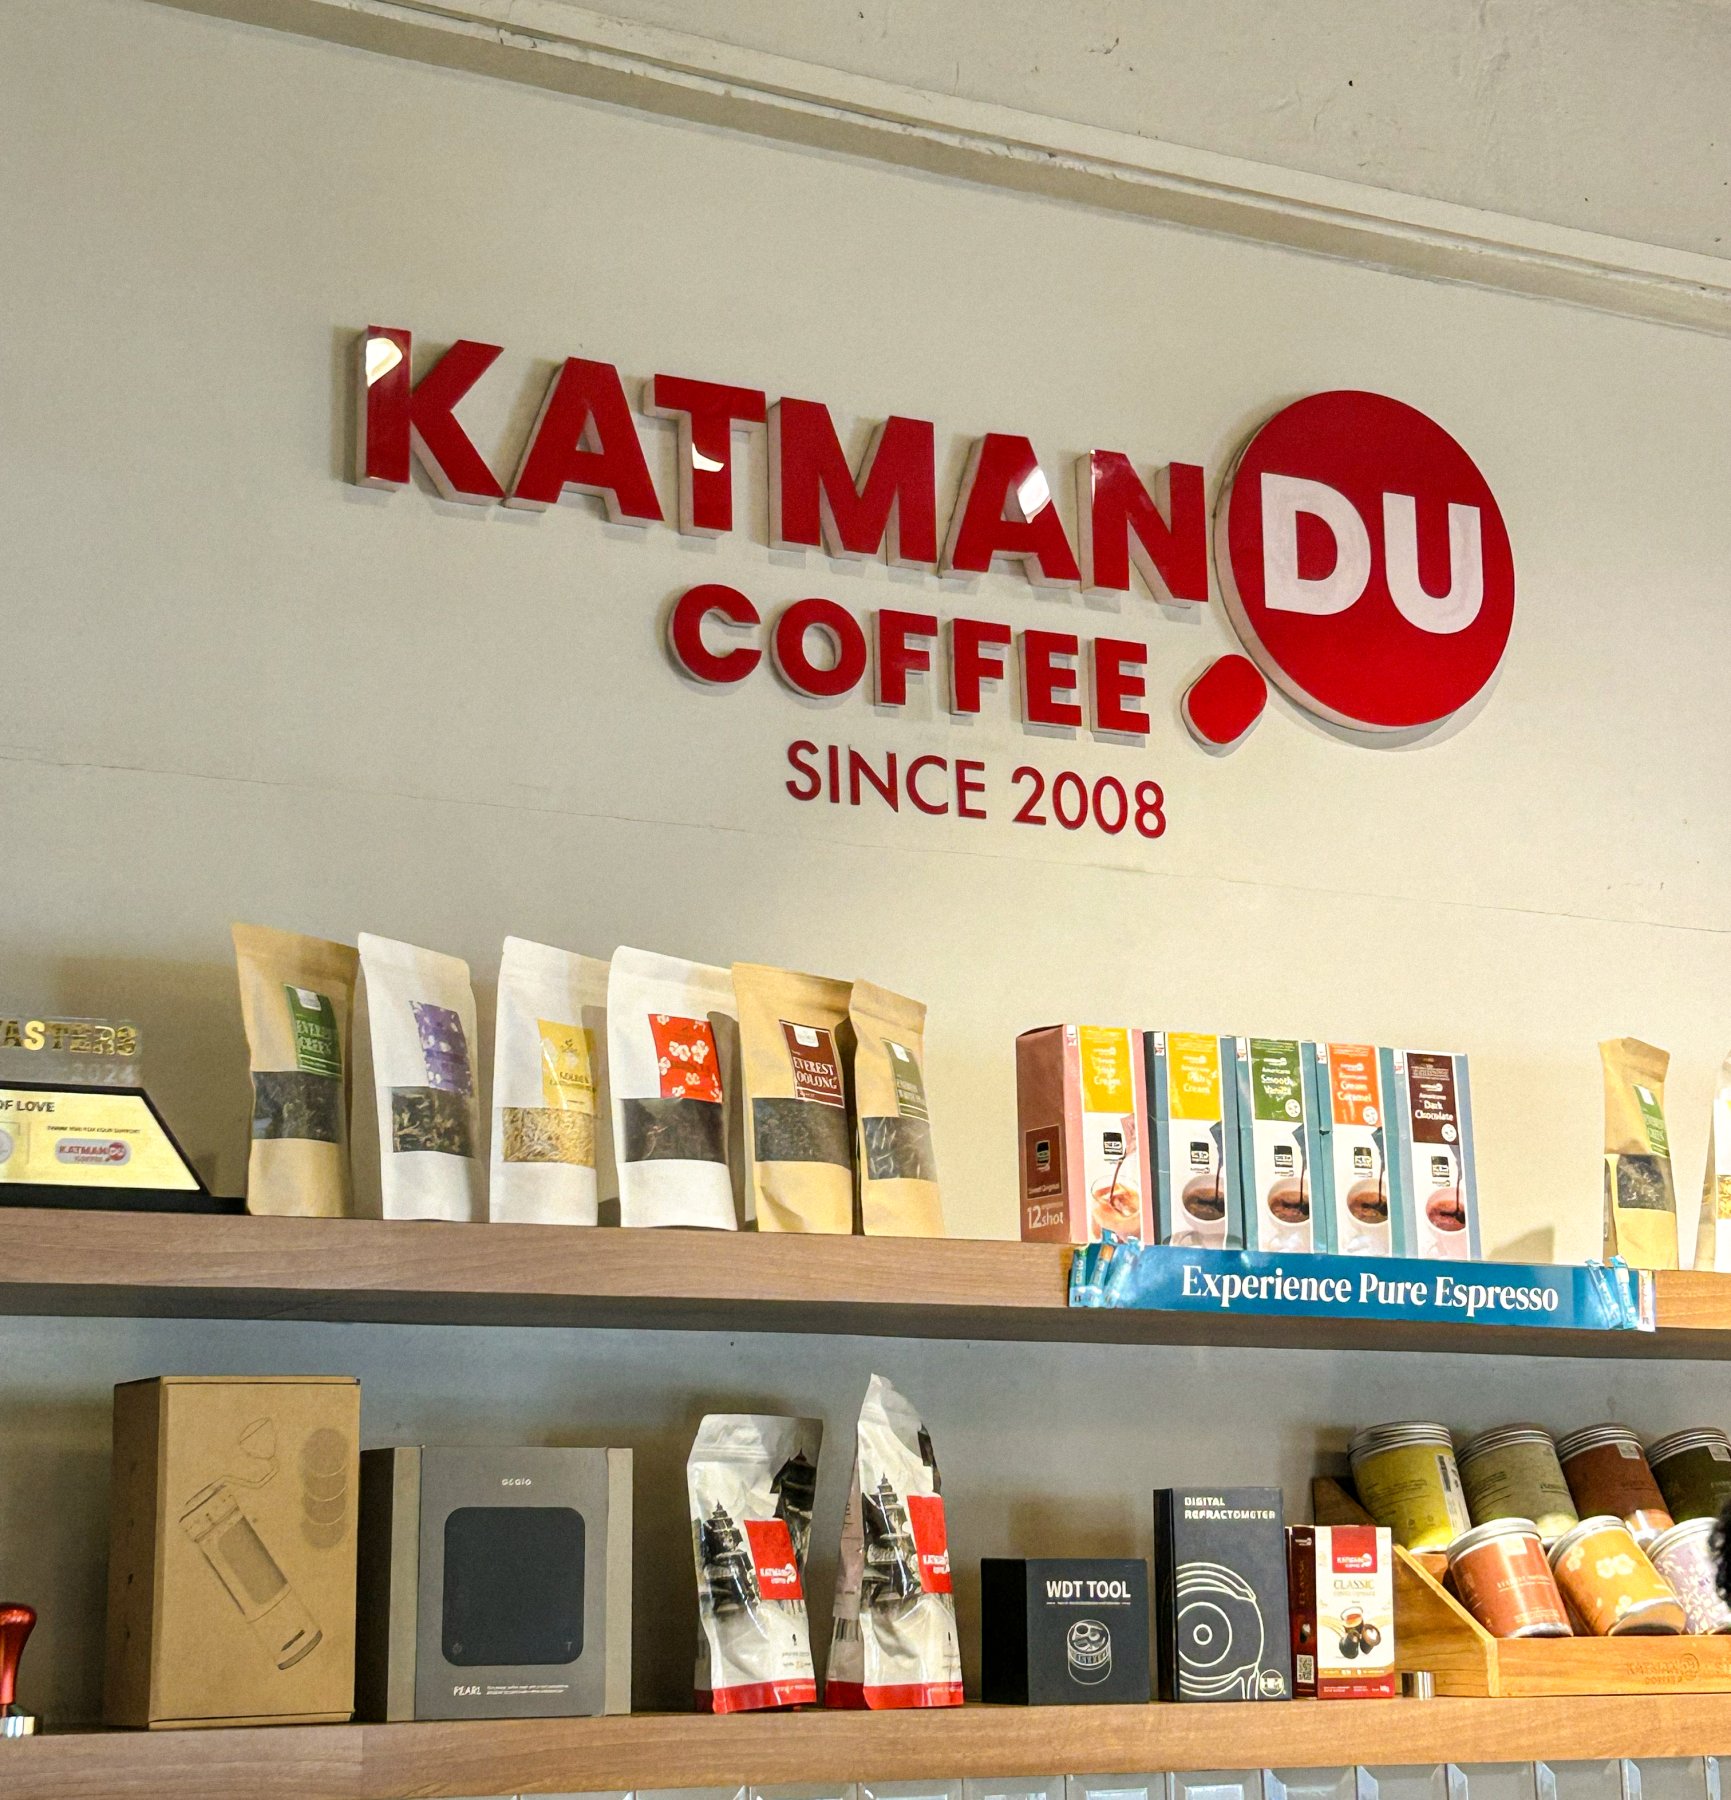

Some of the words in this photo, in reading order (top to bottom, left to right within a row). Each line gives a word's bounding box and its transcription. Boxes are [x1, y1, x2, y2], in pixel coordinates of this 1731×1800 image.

[671, 584, 1151, 735] COFFEE
[786, 740, 987, 819] SINCE
[1011, 766, 1167, 839] 2008
[0, 1020, 137, 1056] ASTERS
[793, 1056, 834, 1076] EVEREST
[796, 1071, 838, 1090] OOLONG
[17, 1101, 55, 1112] LOVE
[1182, 1264, 1352, 1308] Experience
[1359, 1273, 1428, 1304] Pure
[1434, 1276, 1559, 1318] Espresso
[1184, 1497, 1226, 1506] DIGITAL
[1184, 1509, 1276, 1520] REFRACTOMETER
[1046, 1581, 1083, 1598] WDT
[1086, 1580, 1131, 1598] TOOL
[1333, 1579, 1375, 1590] CLASSIC
